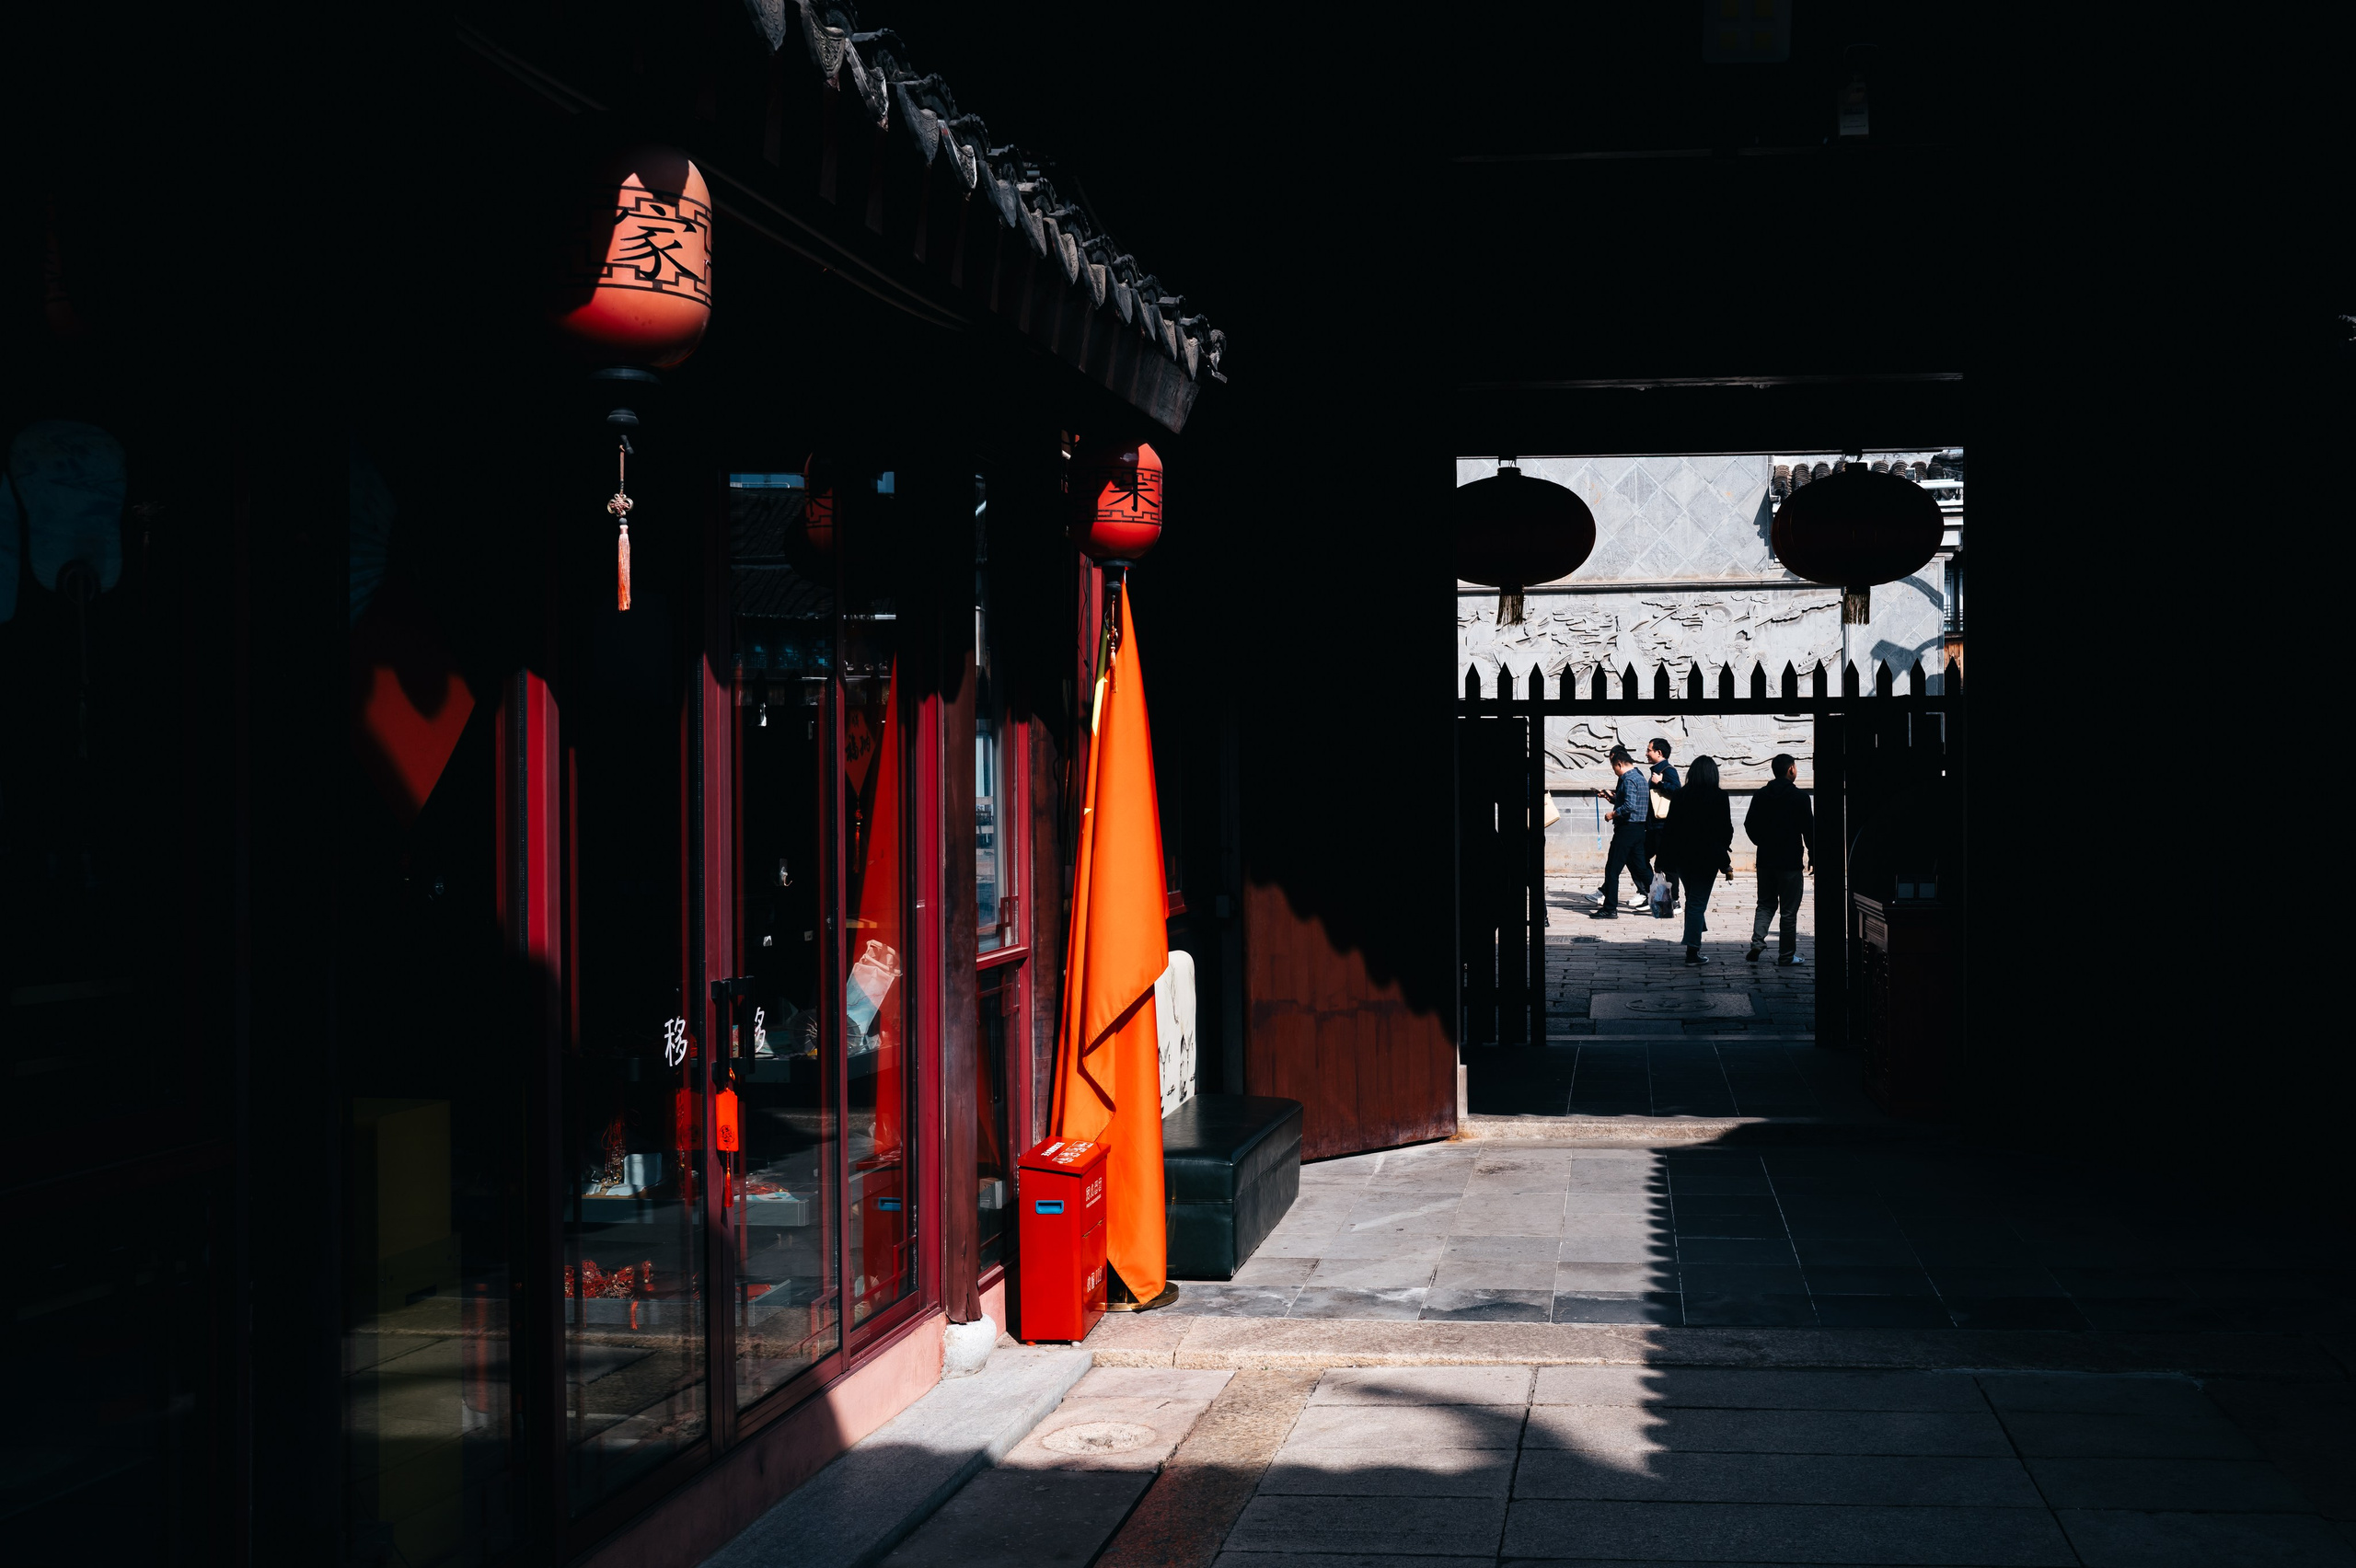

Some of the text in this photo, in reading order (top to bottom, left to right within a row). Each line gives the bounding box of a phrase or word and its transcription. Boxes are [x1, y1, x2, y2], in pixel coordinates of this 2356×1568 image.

[612, 204, 699, 281] 家
[1105, 470, 1159, 513] 朱
[664, 1016, 688, 1066] 移
